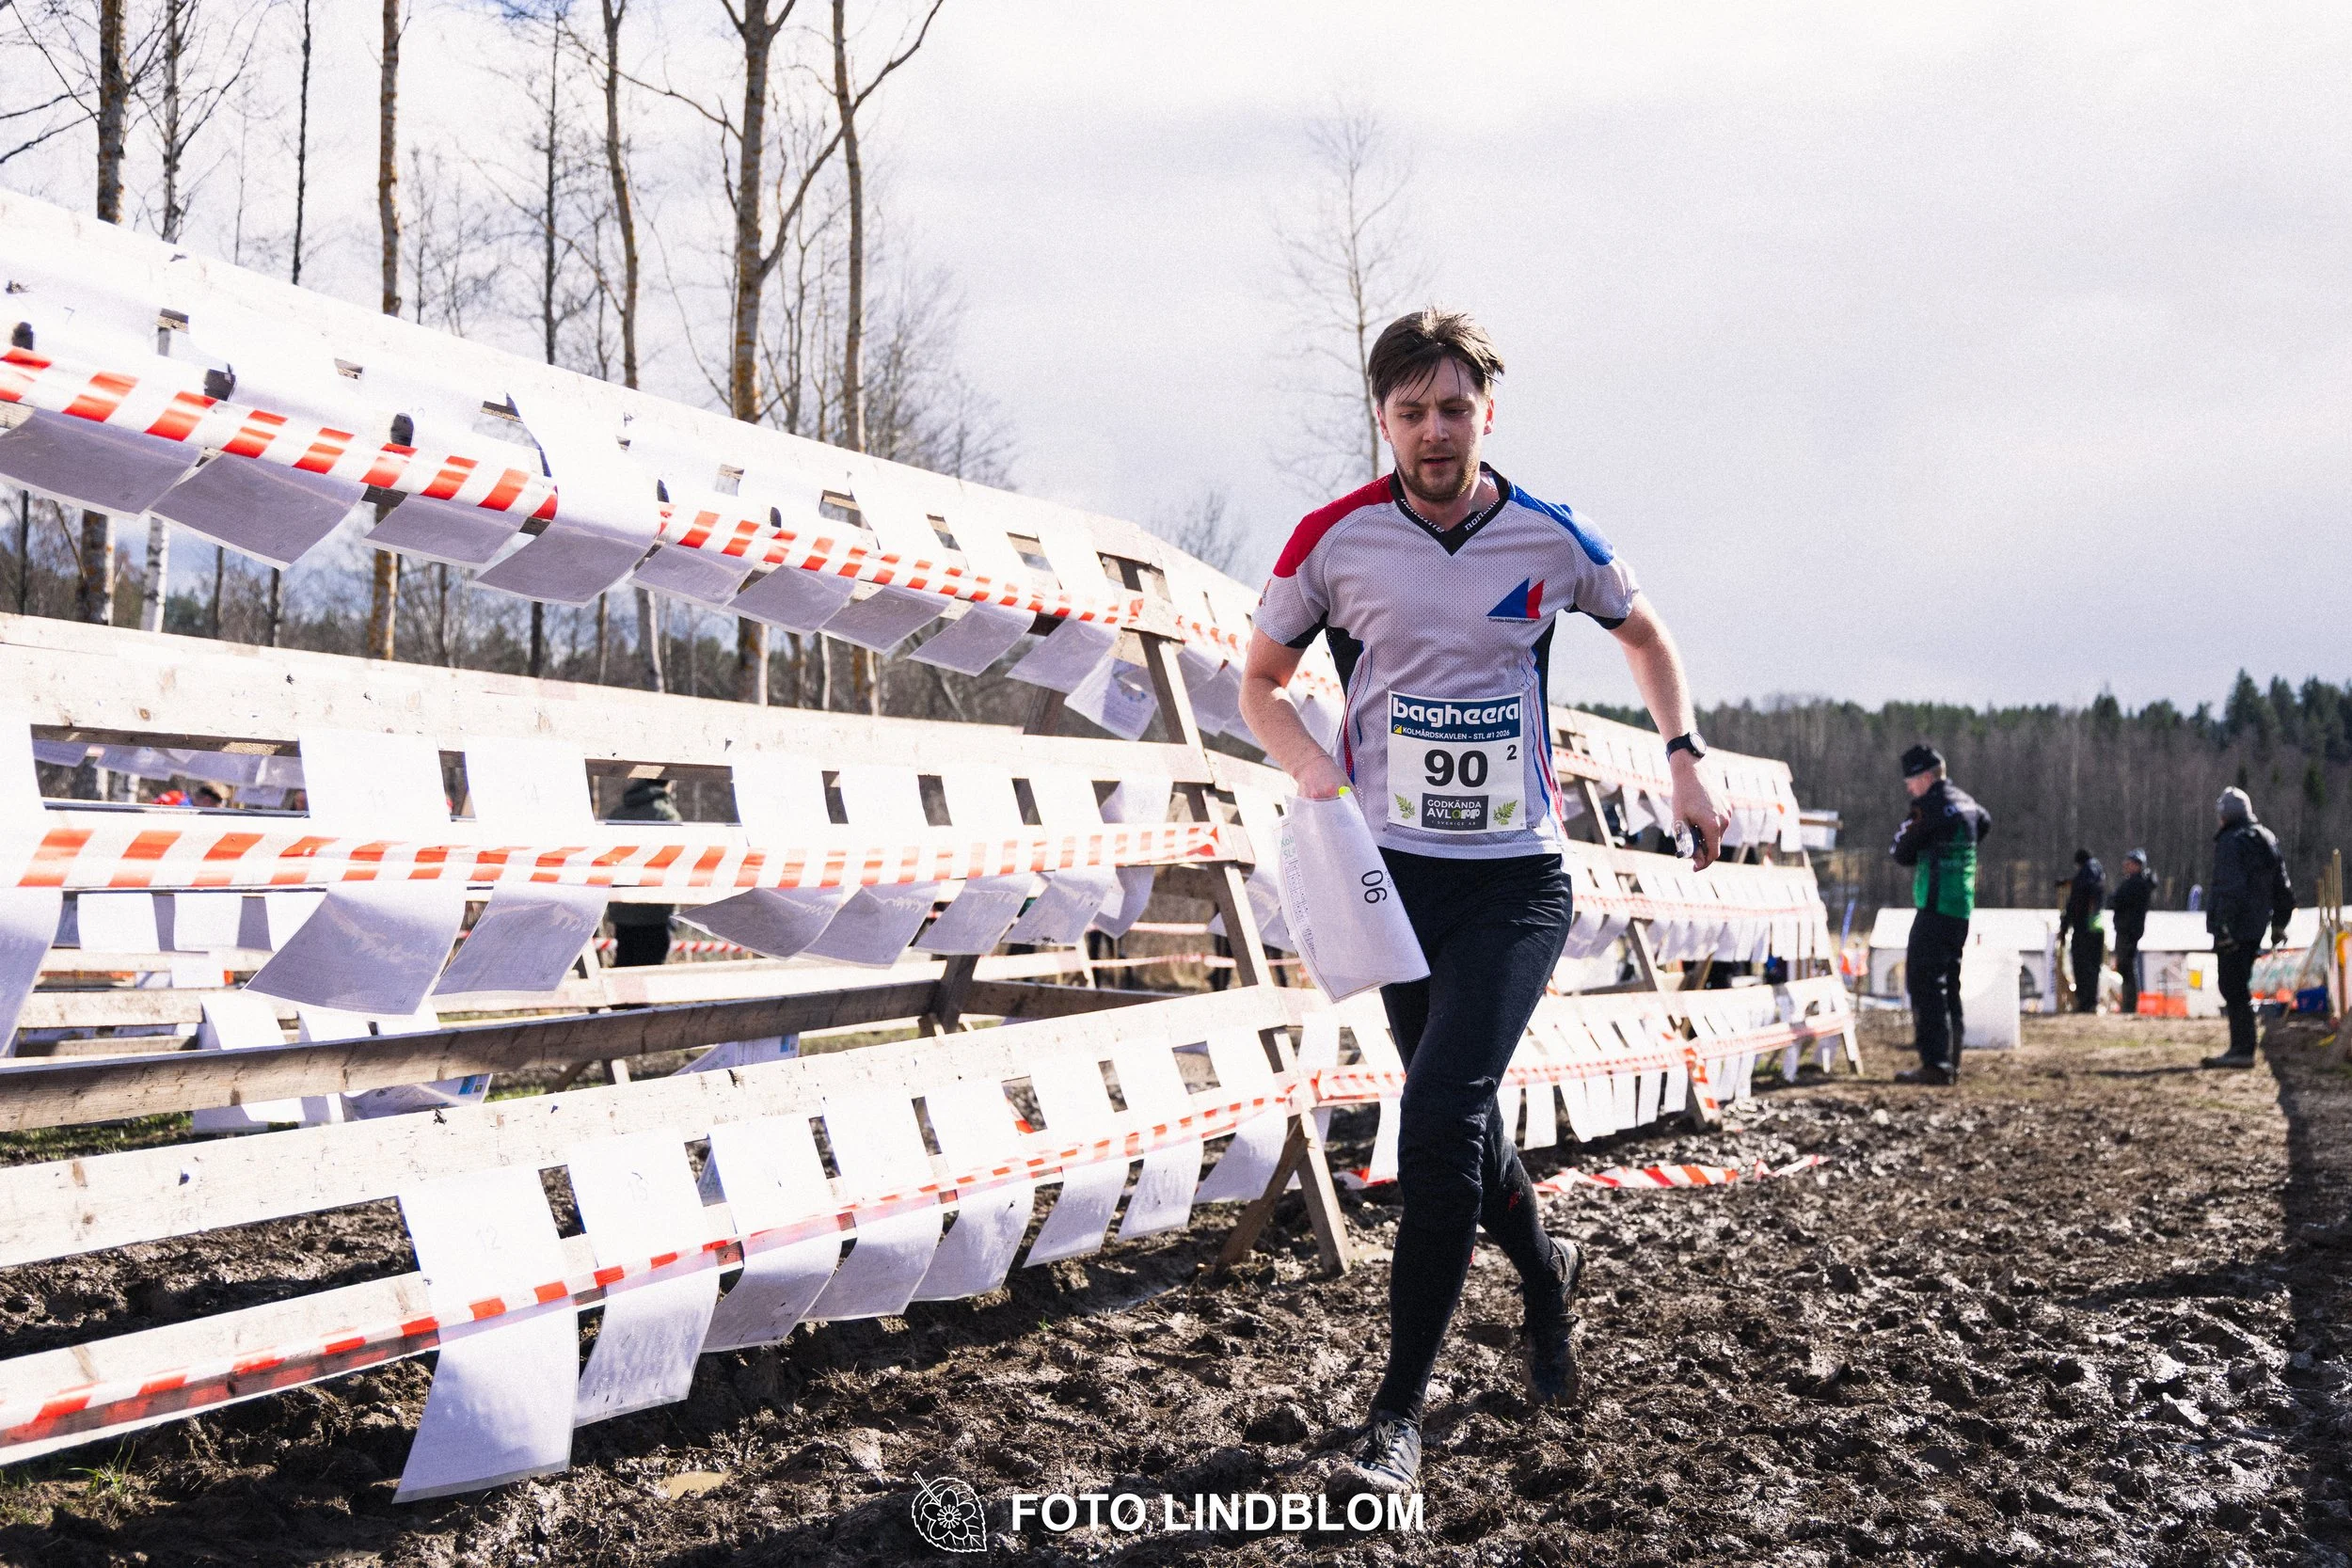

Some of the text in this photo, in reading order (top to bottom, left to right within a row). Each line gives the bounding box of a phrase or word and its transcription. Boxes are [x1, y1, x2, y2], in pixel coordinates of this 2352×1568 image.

[1392, 697, 1519, 728] bagheera
[1403, 726, 1468, 739] KOLMÅRDSKAVLEN
[1506, 744, 1518, 761] 2
[1424, 749, 1488, 788] 90
[1427, 800, 1482, 809] GODKÄNDA
[1360, 869, 1388, 904] 90
